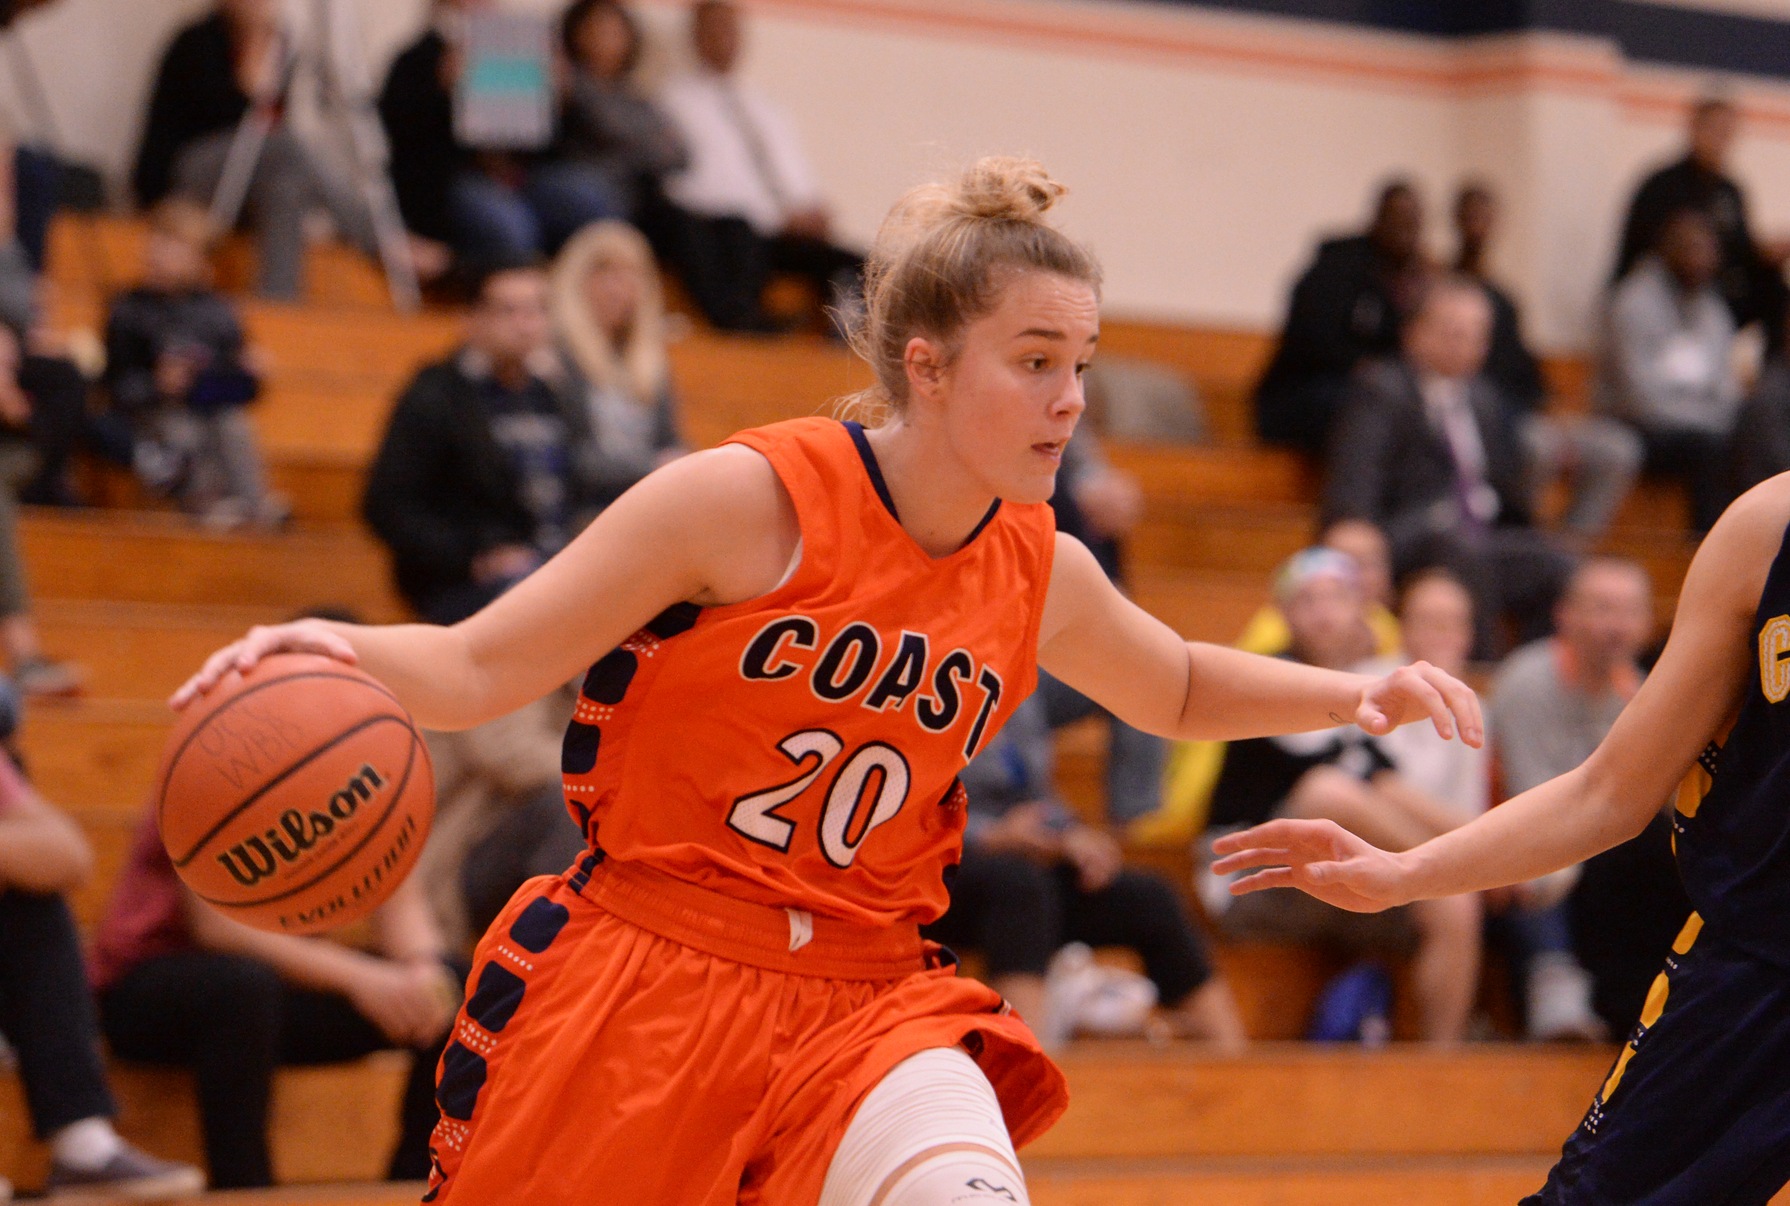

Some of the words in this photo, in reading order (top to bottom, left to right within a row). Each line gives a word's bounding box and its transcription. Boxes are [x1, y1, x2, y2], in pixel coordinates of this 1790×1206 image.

[739, 614, 1003, 766] COAST
[216, 763, 387, 887] Wilson
[725, 727, 911, 869] 20
